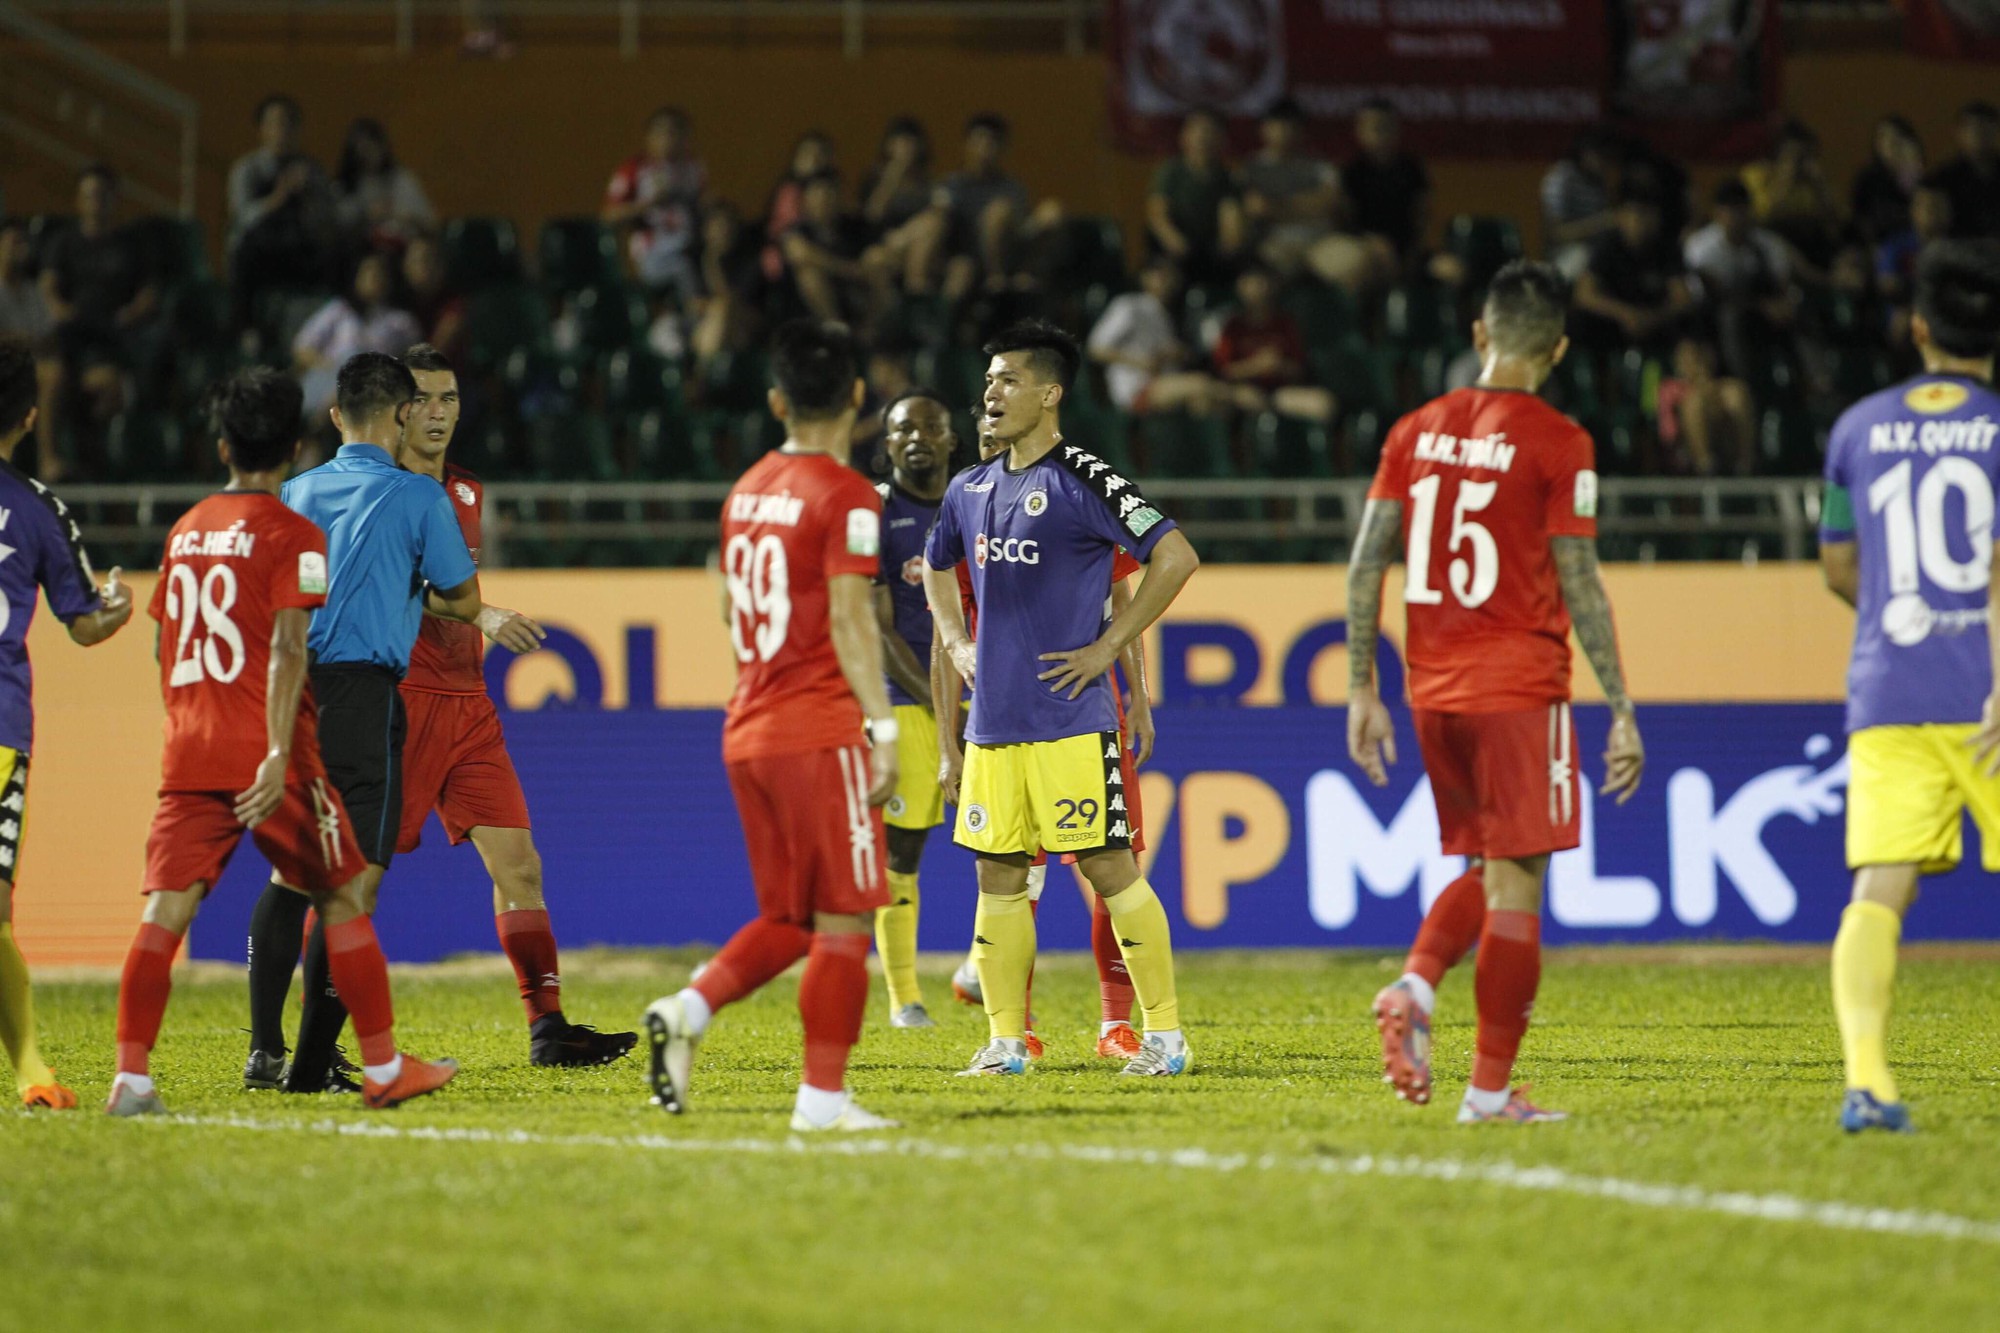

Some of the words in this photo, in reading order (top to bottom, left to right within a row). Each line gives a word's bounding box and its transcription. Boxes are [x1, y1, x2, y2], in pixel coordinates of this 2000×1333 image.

[989, 537, 1039, 565] SCG
[1404, 474, 1499, 609] 15
[1868, 455, 1995, 593] 10
[165, 563, 246, 687] 28
[726, 533, 791, 663] 89
[1054, 798, 1099, 829] 29
[1056, 831, 1098, 843] Kappa
